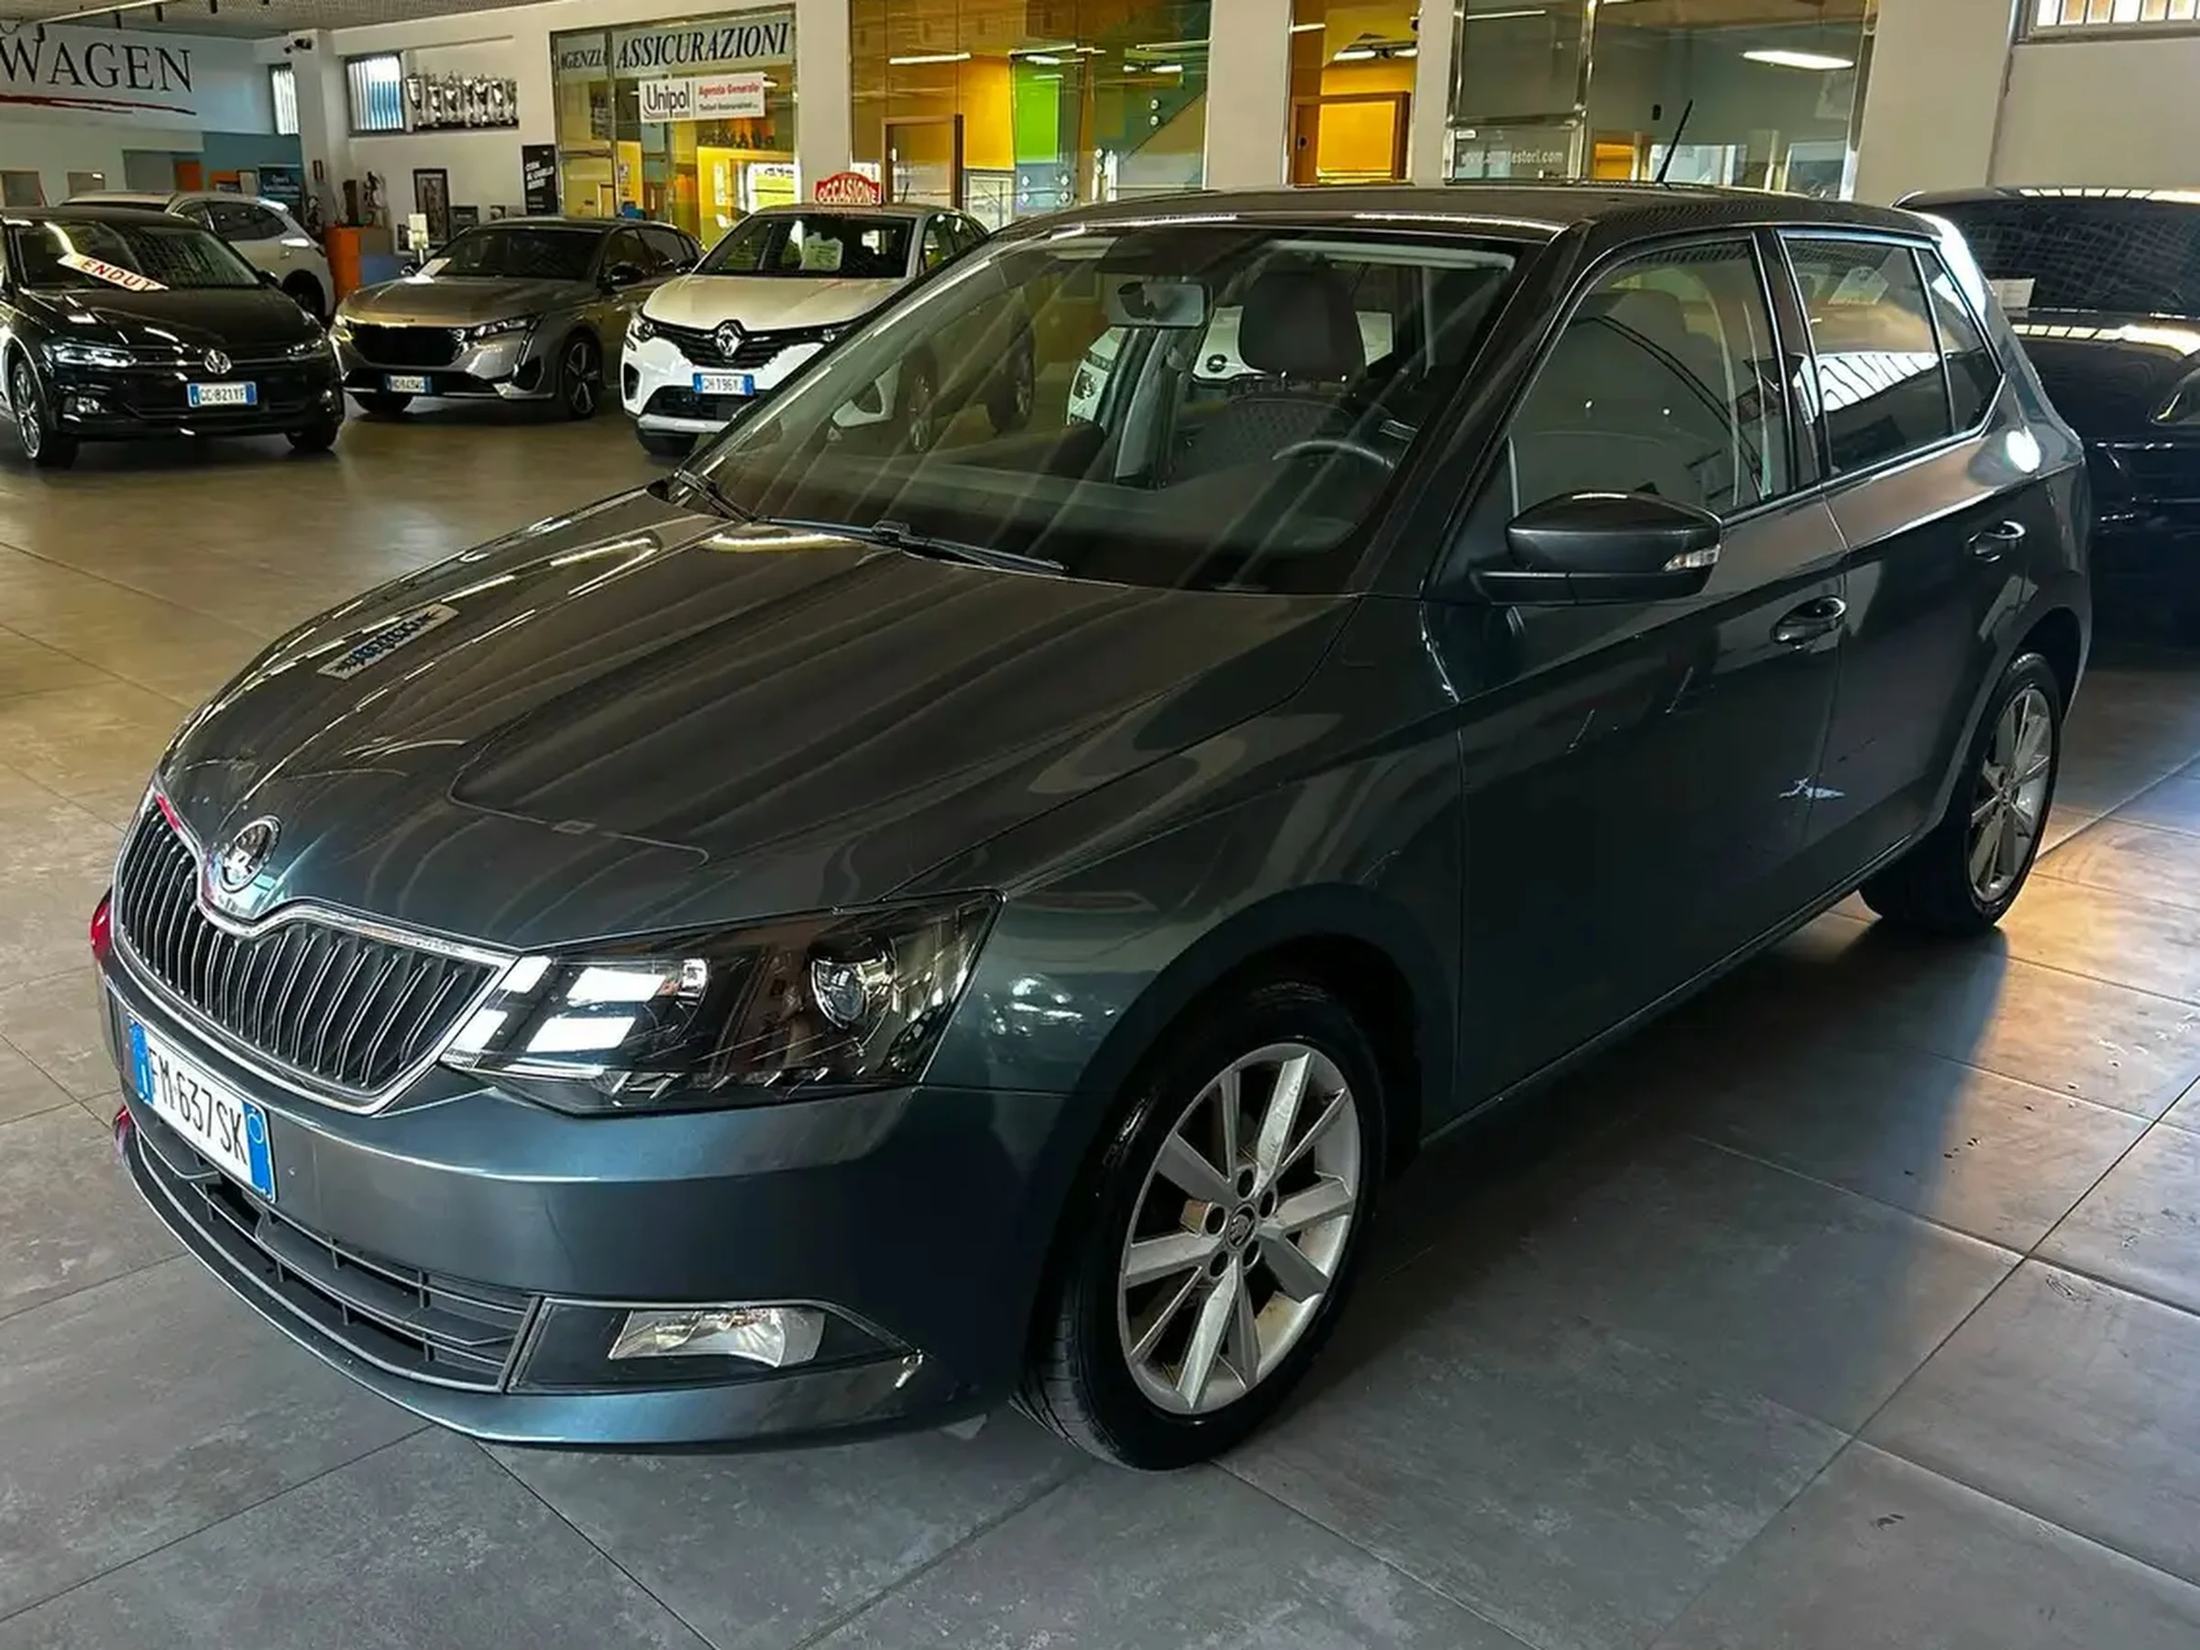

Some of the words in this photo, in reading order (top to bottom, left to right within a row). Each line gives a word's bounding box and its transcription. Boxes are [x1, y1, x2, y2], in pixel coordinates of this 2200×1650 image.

[616, 22, 789, 69] ASSICURAZIONI
[0, 36, 192, 93] WAGEN
[643, 81, 690, 118] Unipol
[818, 178, 878, 205] OCCASIONE
[80, 259, 156, 291] ENDUT
